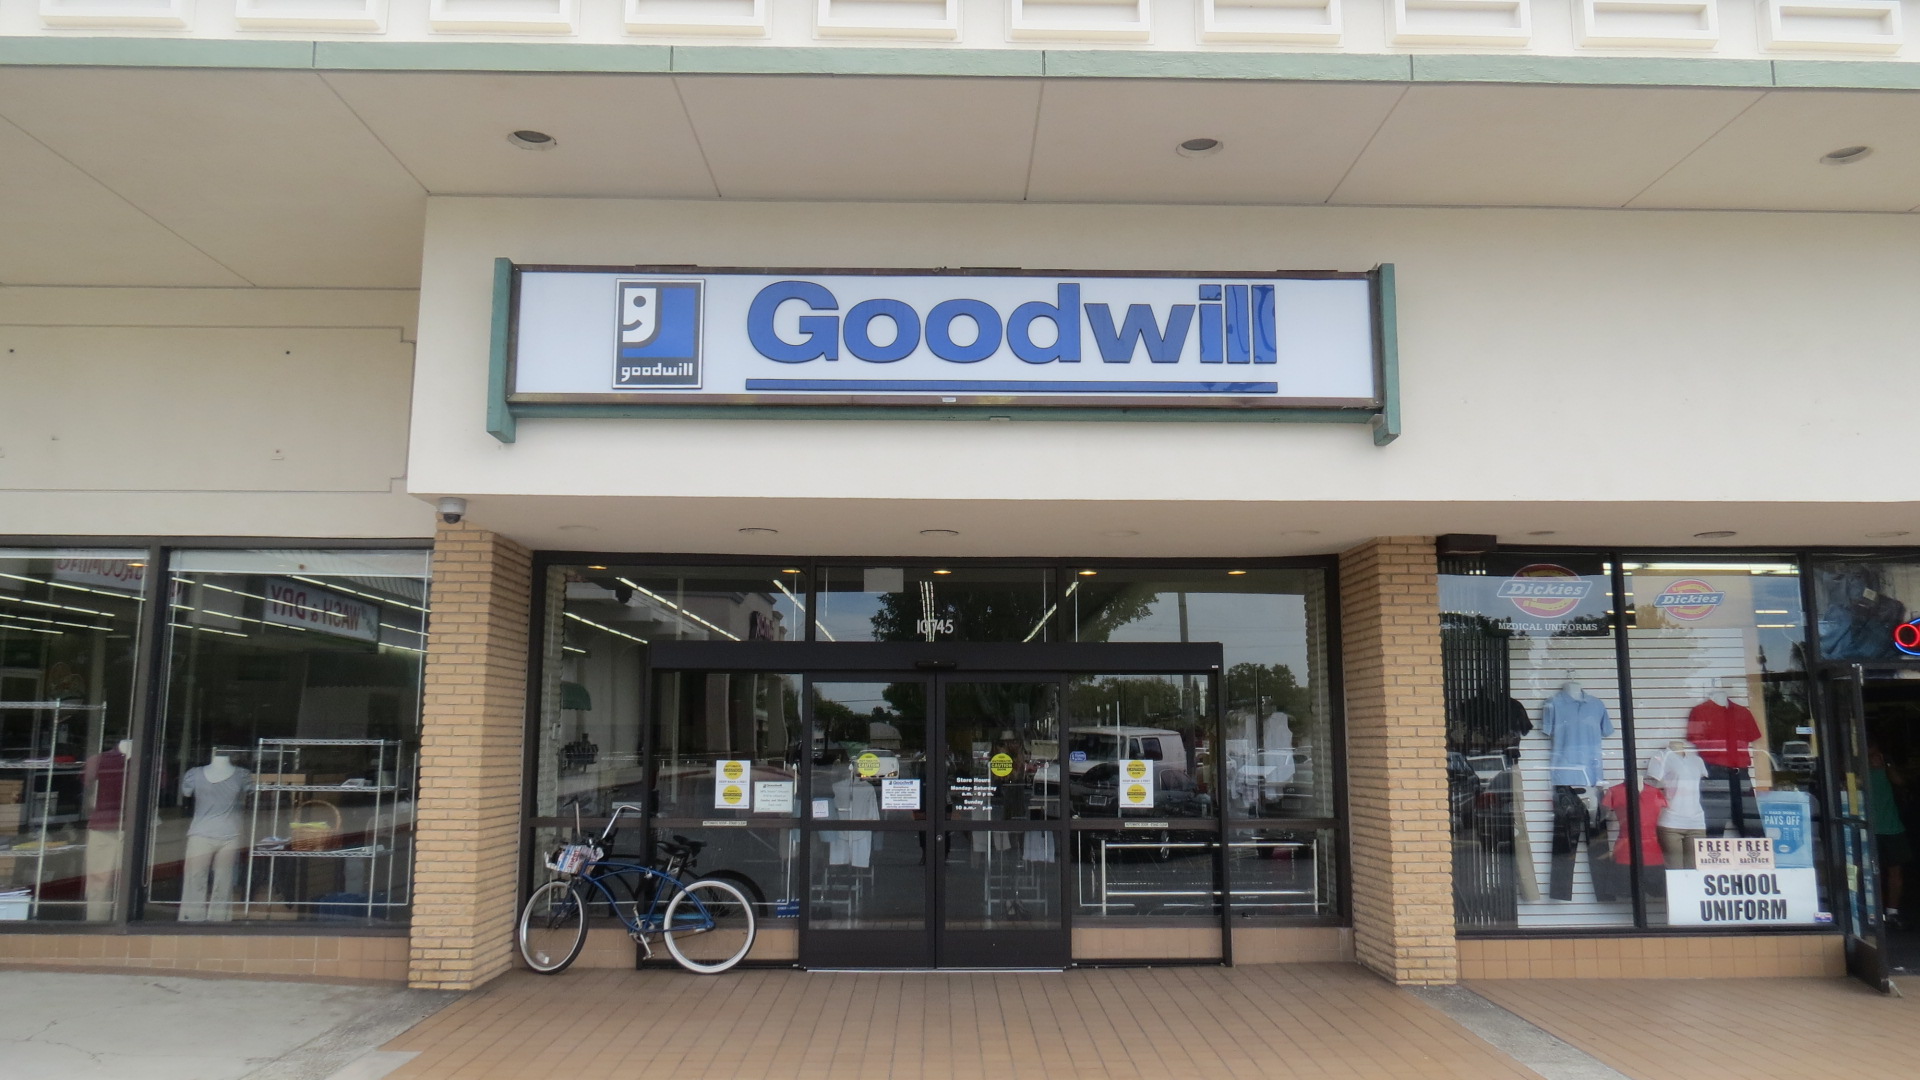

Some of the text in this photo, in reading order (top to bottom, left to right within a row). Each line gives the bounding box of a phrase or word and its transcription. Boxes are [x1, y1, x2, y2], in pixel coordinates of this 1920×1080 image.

[747, 280, 1277, 364] Goodwill
[621, 362, 693, 382] goodwill
[1507, 583, 1584, 596] Dickies
[1661, 594, 1718, 605] Dickies
[916, 619, 954, 634] 10745
[1498, 622, 1598, 631] MEDICAL UNIFORMS
[1764, 815, 1801, 826] PAYS OFF
[1698, 840, 1730, 852] FREE
[1737, 840, 1770, 852] FREE
[1703, 873, 1781, 896] SCHOOL
[1700, 898, 1788, 922] UNIFORM
